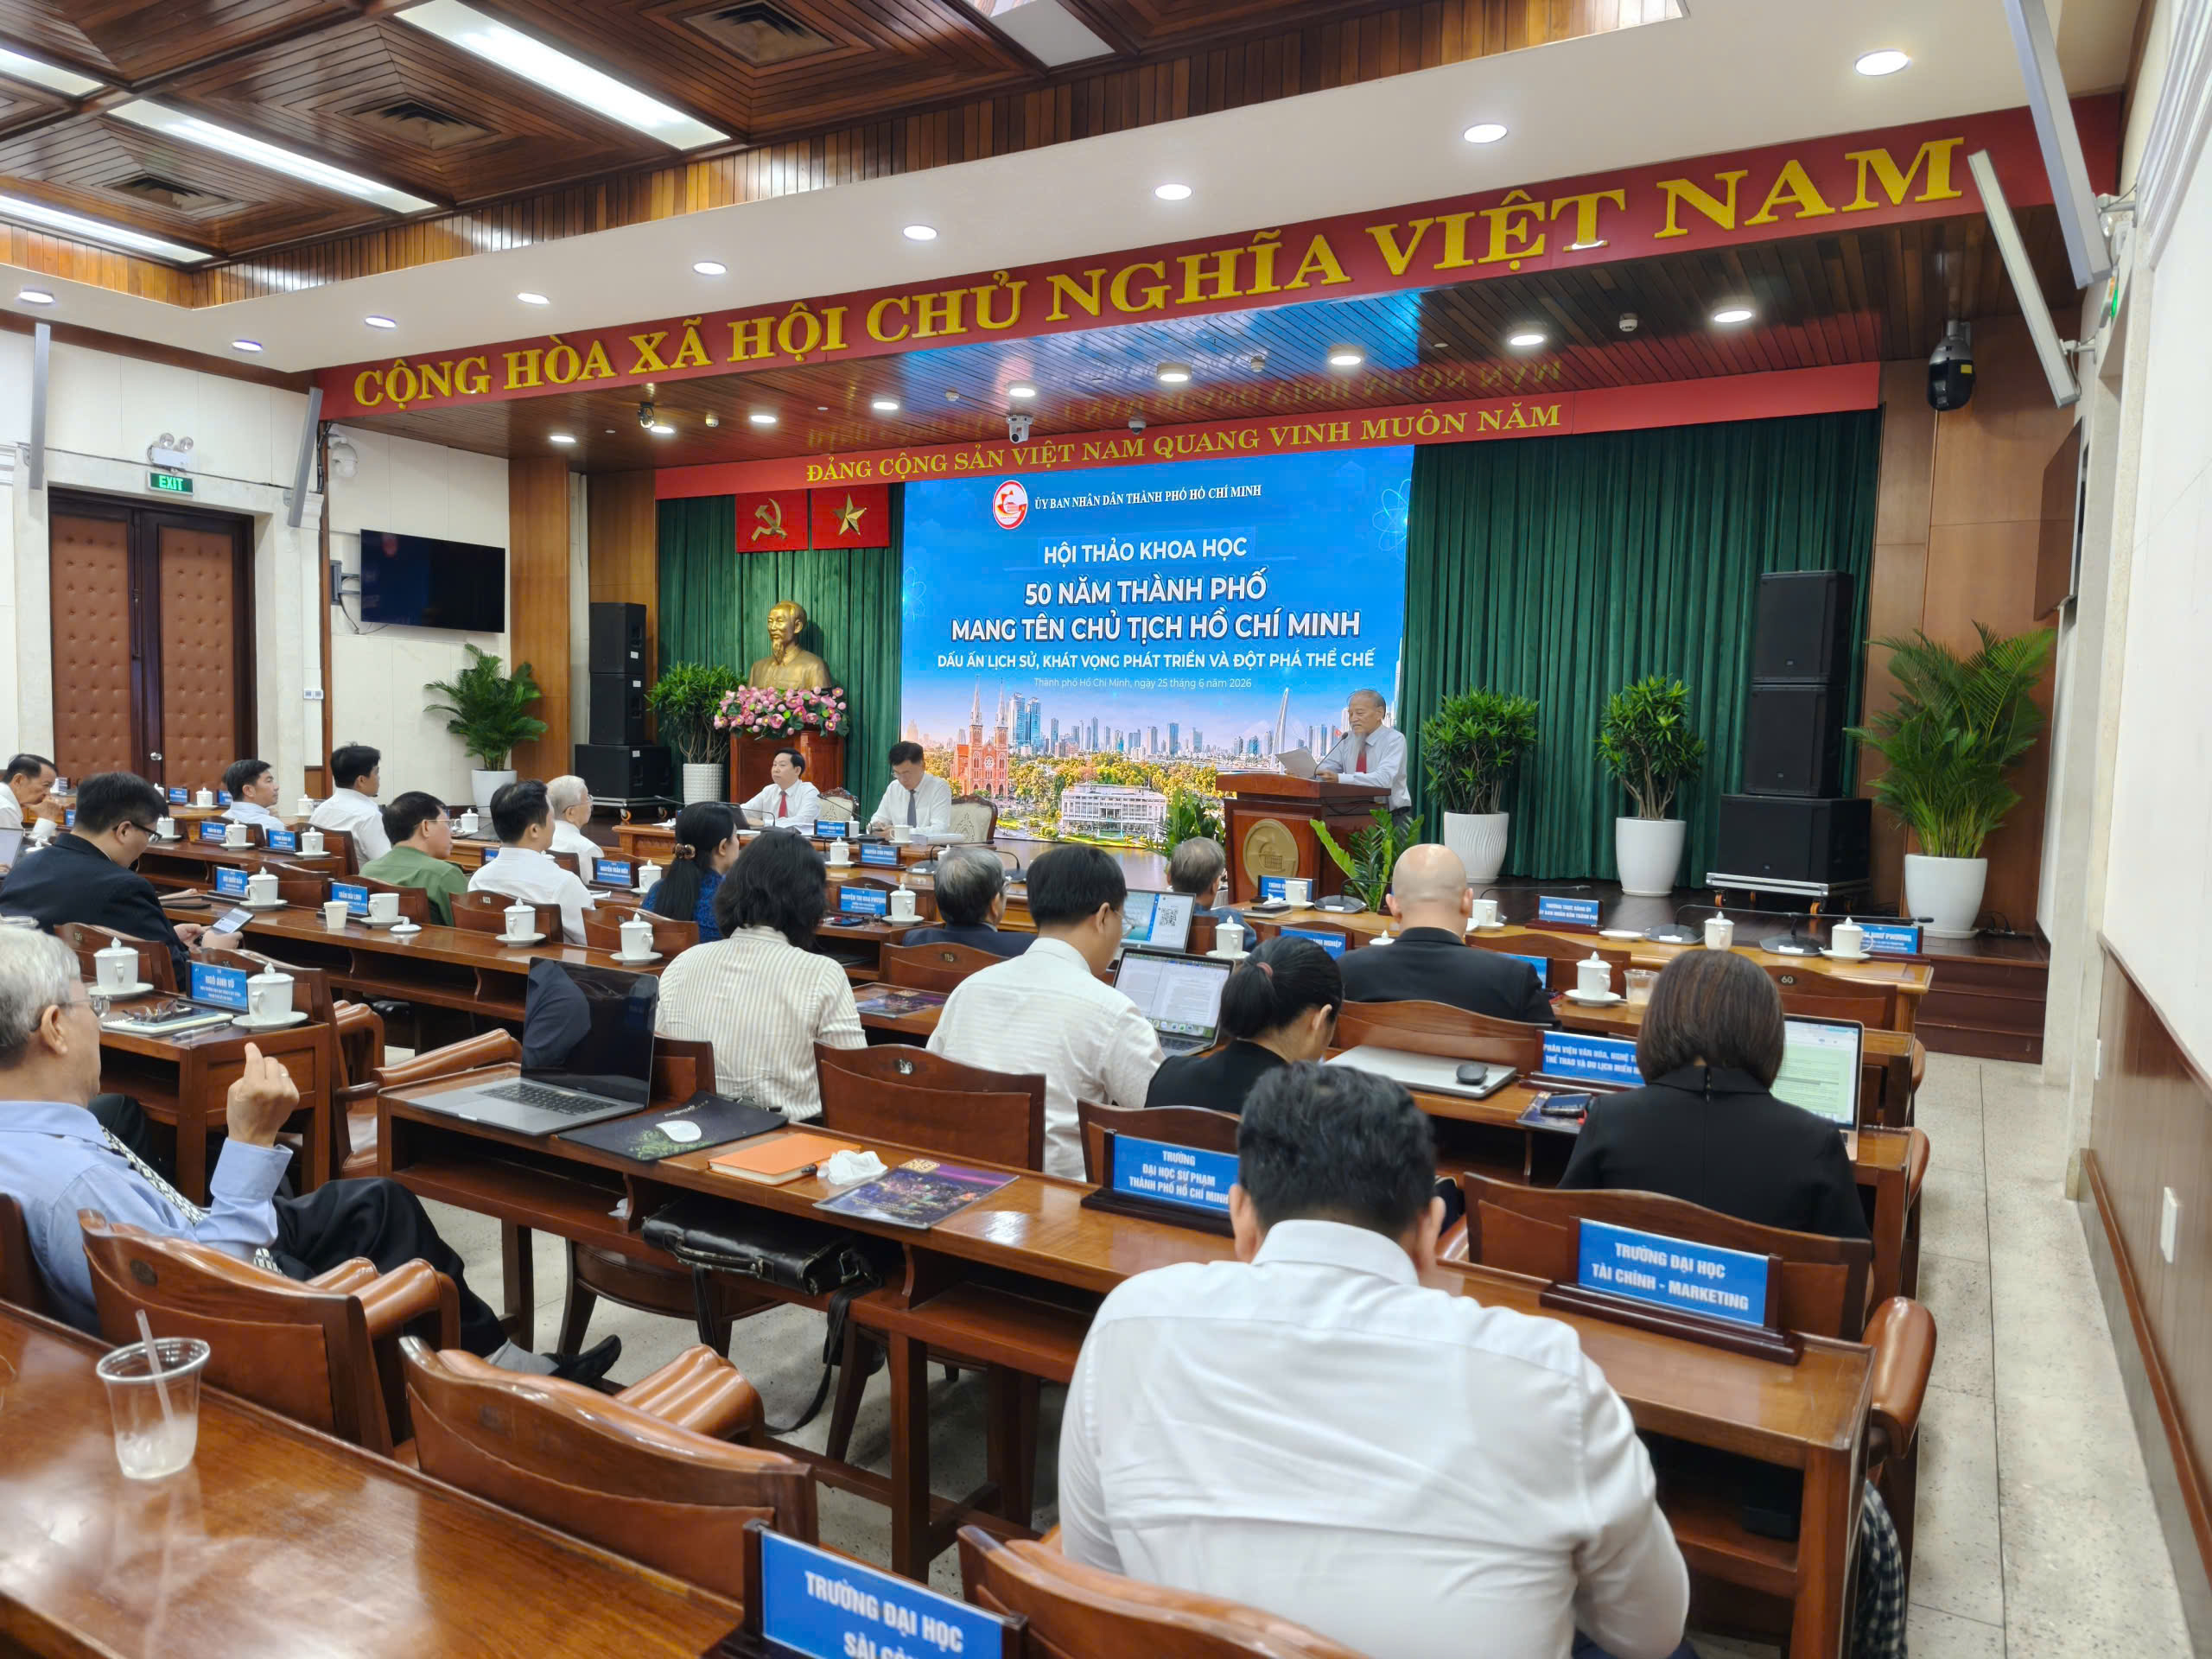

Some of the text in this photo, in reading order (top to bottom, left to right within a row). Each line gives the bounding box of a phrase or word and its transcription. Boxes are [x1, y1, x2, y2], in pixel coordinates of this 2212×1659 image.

[353, 137, 1964, 410] CỘNG HÒA XÃ HỘI CHỦ NGHĨA VIỆT NAM
[806, 402, 1561, 482] ĐẢNG CỘNG SẢN VIỆT NAM QUANG VINH MUÔN NĂM
[159, 474, 183, 491] EXIT
[1051, 496, 1071, 509] BAN
[1071, 493, 1101, 507] NHÂN
[1103, 492, 1124, 506] DÂN
[1126, 490, 1162, 505] THÀNH
[1208, 484, 1228, 498] CHÍ
[1230, 485, 1262, 497] MINH
[1044, 537, 1247, 568] HỘI THẢO KHOA HỌC
[1025, 567, 1268, 605] 50 NĂM THÀNH PHỐ
[951, 607, 1361, 645] MANG TÊN CHỦ TỊCH HỒ CHÍ MINH
[938, 651, 963, 668] DẤU
[967, 651, 984, 668] ẤN
[988, 653, 1016, 671] LỊCH
[1019, 651, 1039, 670] SỬ,
[1043, 652, 1077, 668] KHÁT
[1080, 653, 1120, 671] VỌNG
[1123, 652, 1161, 668] PHÁT
[1164, 650, 1205, 668] TRIỂN
[1209, 651, 1230, 667] VÀ
[1233, 651, 1266, 671] ĐỘT
[1269, 649, 1302, 667] PHÁ
[1340, 647, 1376, 667] CHẾ
[1033, 677, 1059, 687] Thành
[1134, 678, 1156, 690] ngày
[1158, 678, 1167, 688] 25
[1170, 677, 1196, 690] tháng
[1198, 678, 1205, 688] 6
[1206, 677, 1227, 688] năm
[1229, 678, 1252, 688] 2026
[1560, 1057, 1575, 1065] THAO
[1162, 1150, 1195, 1166] TRƯỜNG
[1142, 1164, 1216, 1187] ĐẠI HỌC SƯ PHẠM
[1129, 1176, 1155, 1192] THÀNH
[1158, 1180, 1174, 1194] PHỐ
[1190, 1187, 1204, 1199] CHÍ
[1205, 1192, 1230, 1205] MINH
[1615, 1243, 1726, 1279] TRƯỜNG ĐẠI HỌC
[1592, 1262, 1612, 1280] TÀI
[1615, 1268, 1656, 1290] CHÍNH
[1669, 1280, 1749, 1311] MARKETING
[804, 1570, 963, 1653] TRƯỜNG ĐẠI HỌC
[843, 1631, 876, 1659] SÀI
